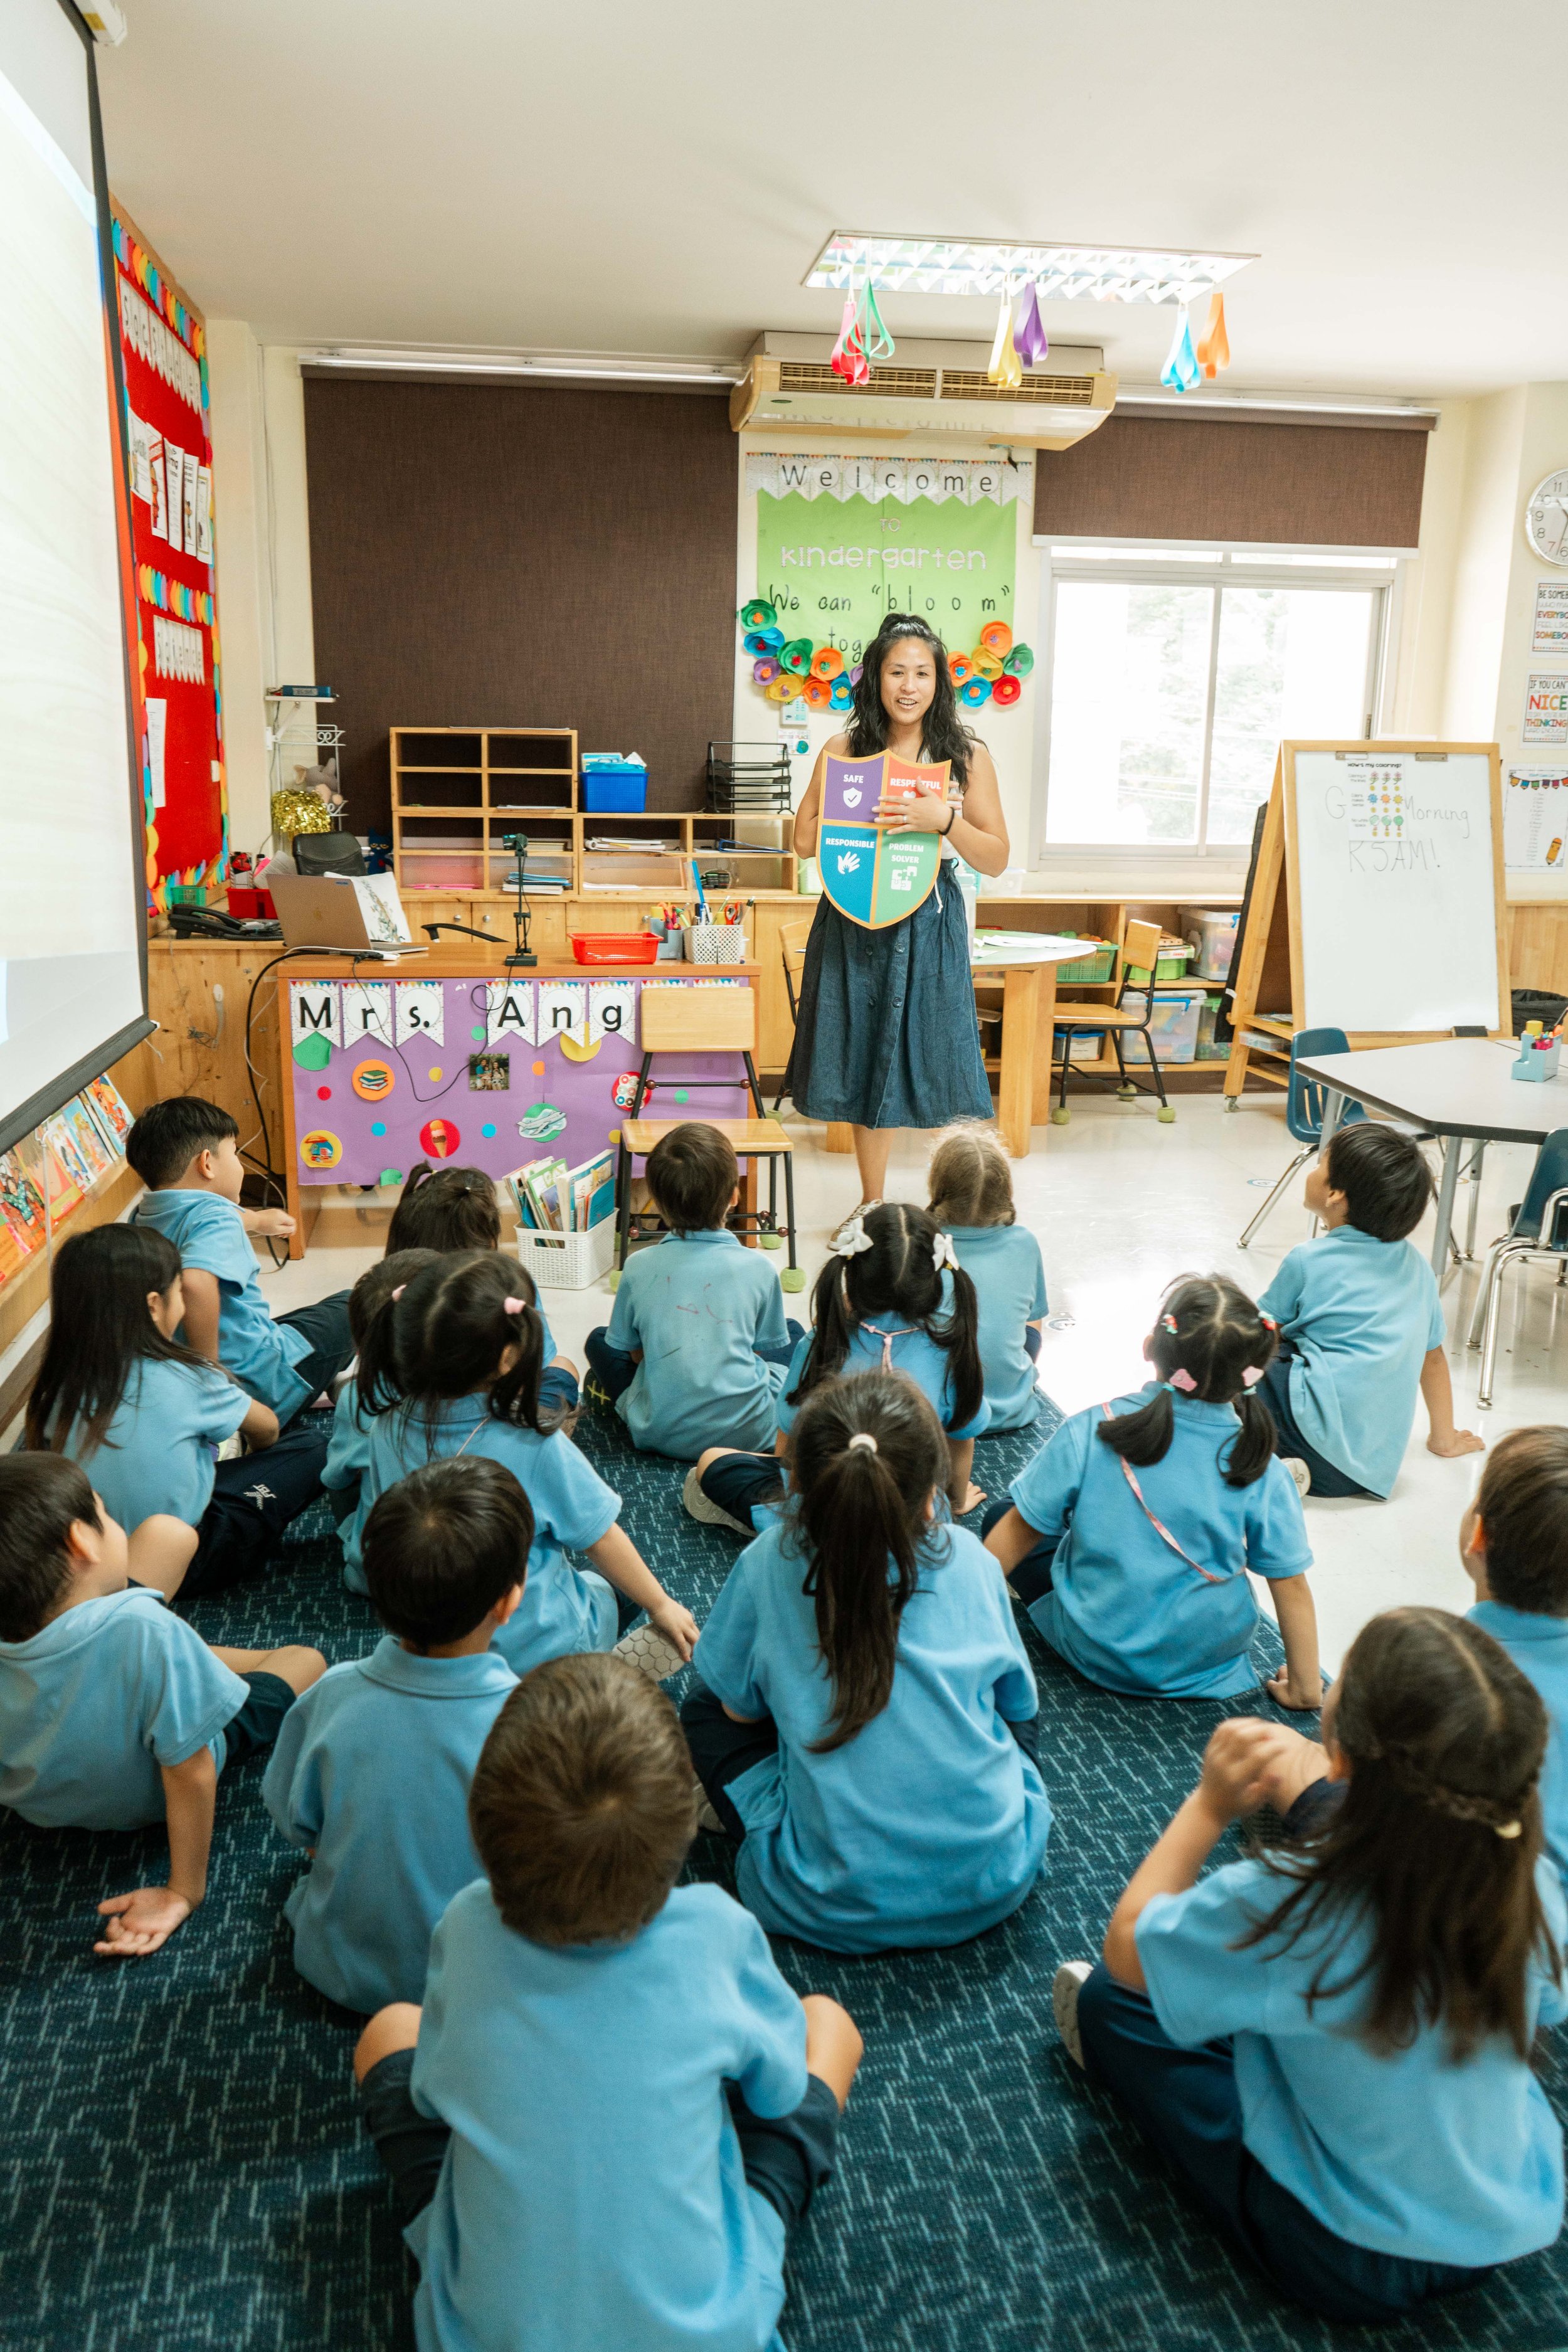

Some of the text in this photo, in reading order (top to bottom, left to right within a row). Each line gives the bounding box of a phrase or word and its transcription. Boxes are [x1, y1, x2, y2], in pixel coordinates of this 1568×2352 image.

[781, 464, 993, 492] Welcome
[1554, 481, 1562, 492] 11
[1535, 511, 1544, 522] 9
[879, 517, 901, 532] TO
[1537, 527, 1545, 538] 8
[1548, 541, 1556, 552] 7
[1560, 546, 1568, 558] 6
[769, 584, 800, 611] We
[818, 595, 851, 611] can
[1530, 680, 1537, 689] IF
[1539, 680, 1551, 689] YOU
[1529, 694, 1568, 711] NICE
[1525, 718, 1567, 728] THINKING
[843, 774, 864, 784] SAFE
[889, 778, 941, 790] RESPETFUL
[1404, 795, 1470, 839] Morning
[825, 837, 875, 849] RESPONSIBLE
[888, 843, 924, 852] PROBLEM
[891, 854, 919, 864] SOLVER
[299, 996, 622, 1032] Mrs. Ang
